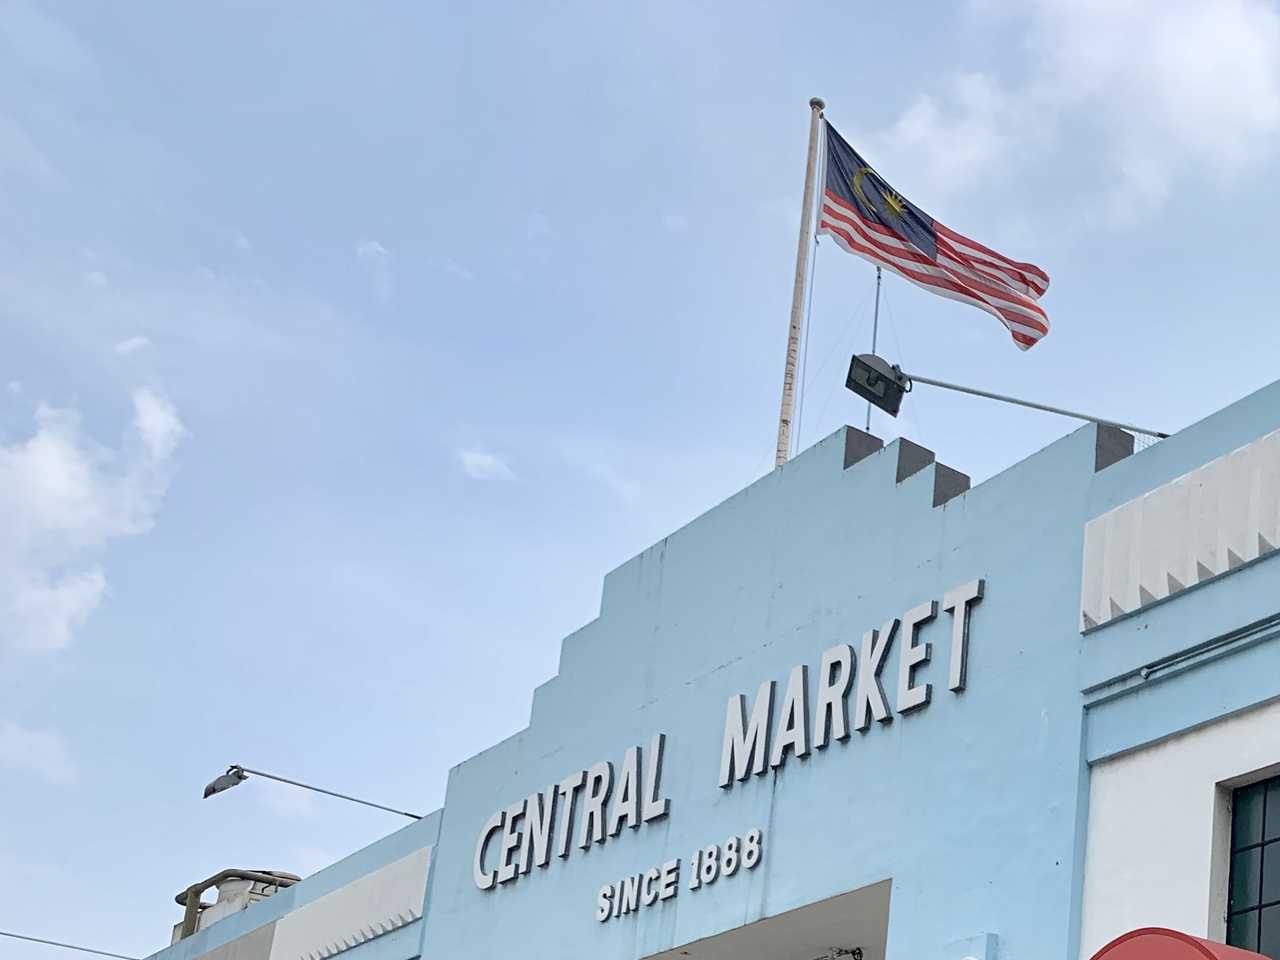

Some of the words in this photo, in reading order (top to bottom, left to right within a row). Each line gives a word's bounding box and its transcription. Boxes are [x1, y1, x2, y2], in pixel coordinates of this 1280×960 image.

[473, 733, 671, 891] CENTRAL
[719, 578, 985, 789] MARKET
[596, 858, 681, 922] SINCE
[689, 827, 762, 892] 1888
